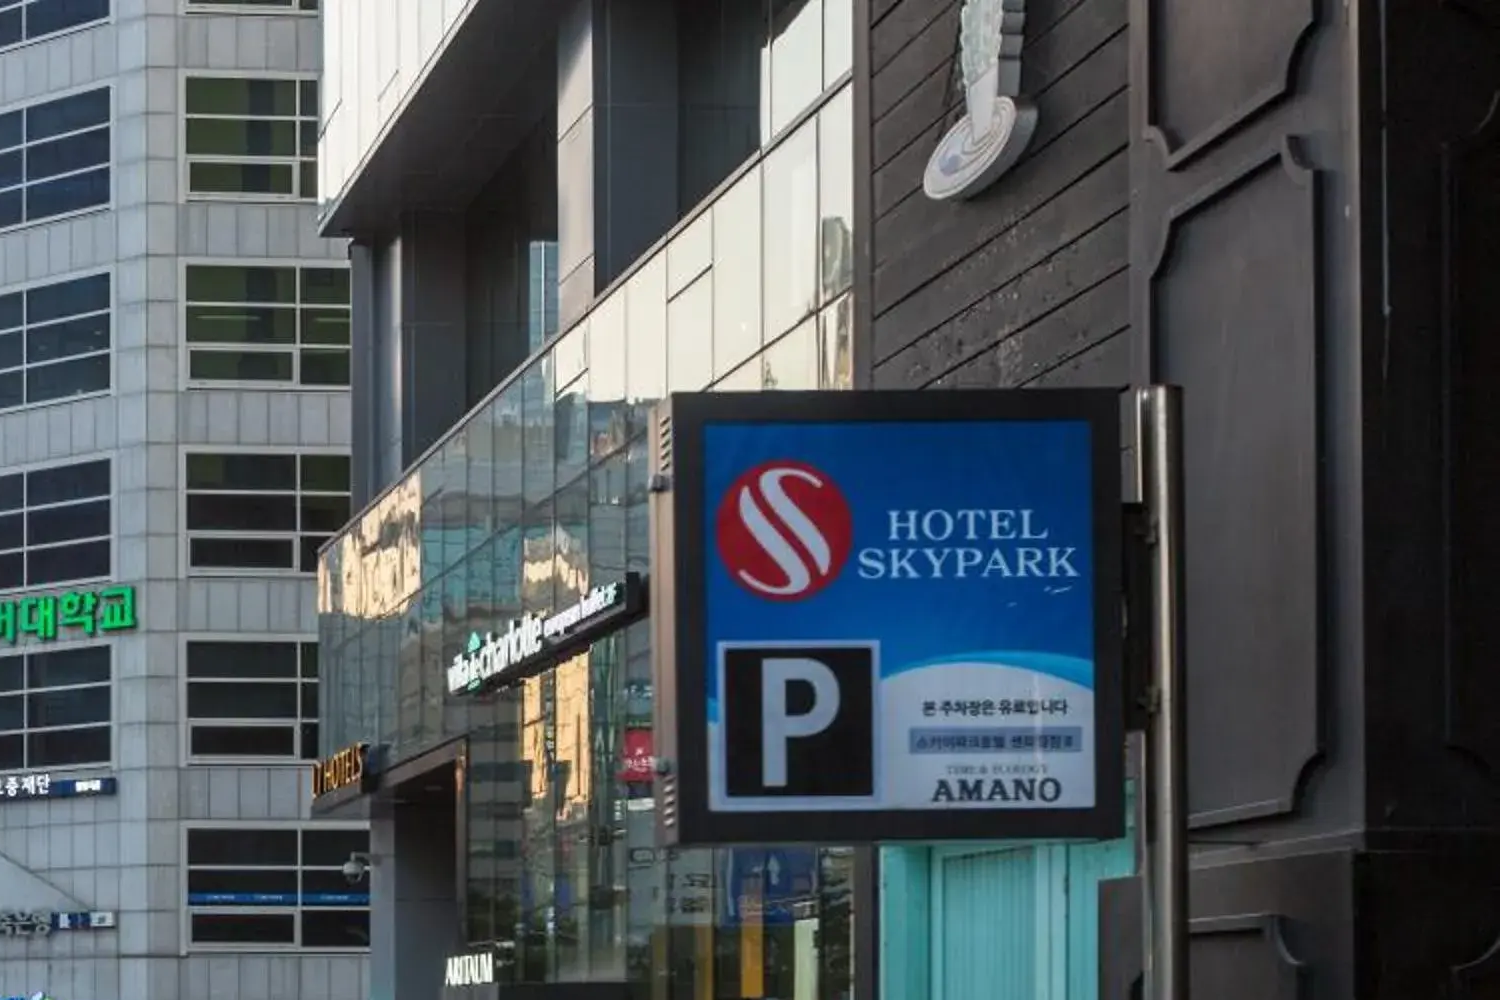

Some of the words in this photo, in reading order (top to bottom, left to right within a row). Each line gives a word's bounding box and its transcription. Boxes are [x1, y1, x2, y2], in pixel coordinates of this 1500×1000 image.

[887, 508, 1049, 541] HOTEL
[857, 547, 1081, 579] SKYPARK
[761, 658, 841, 788] P
[939, 699, 995, 717] 주차장은
[998, 699, 1069, 716] 유료입니다
[931, 777, 1062, 803] AMANO
